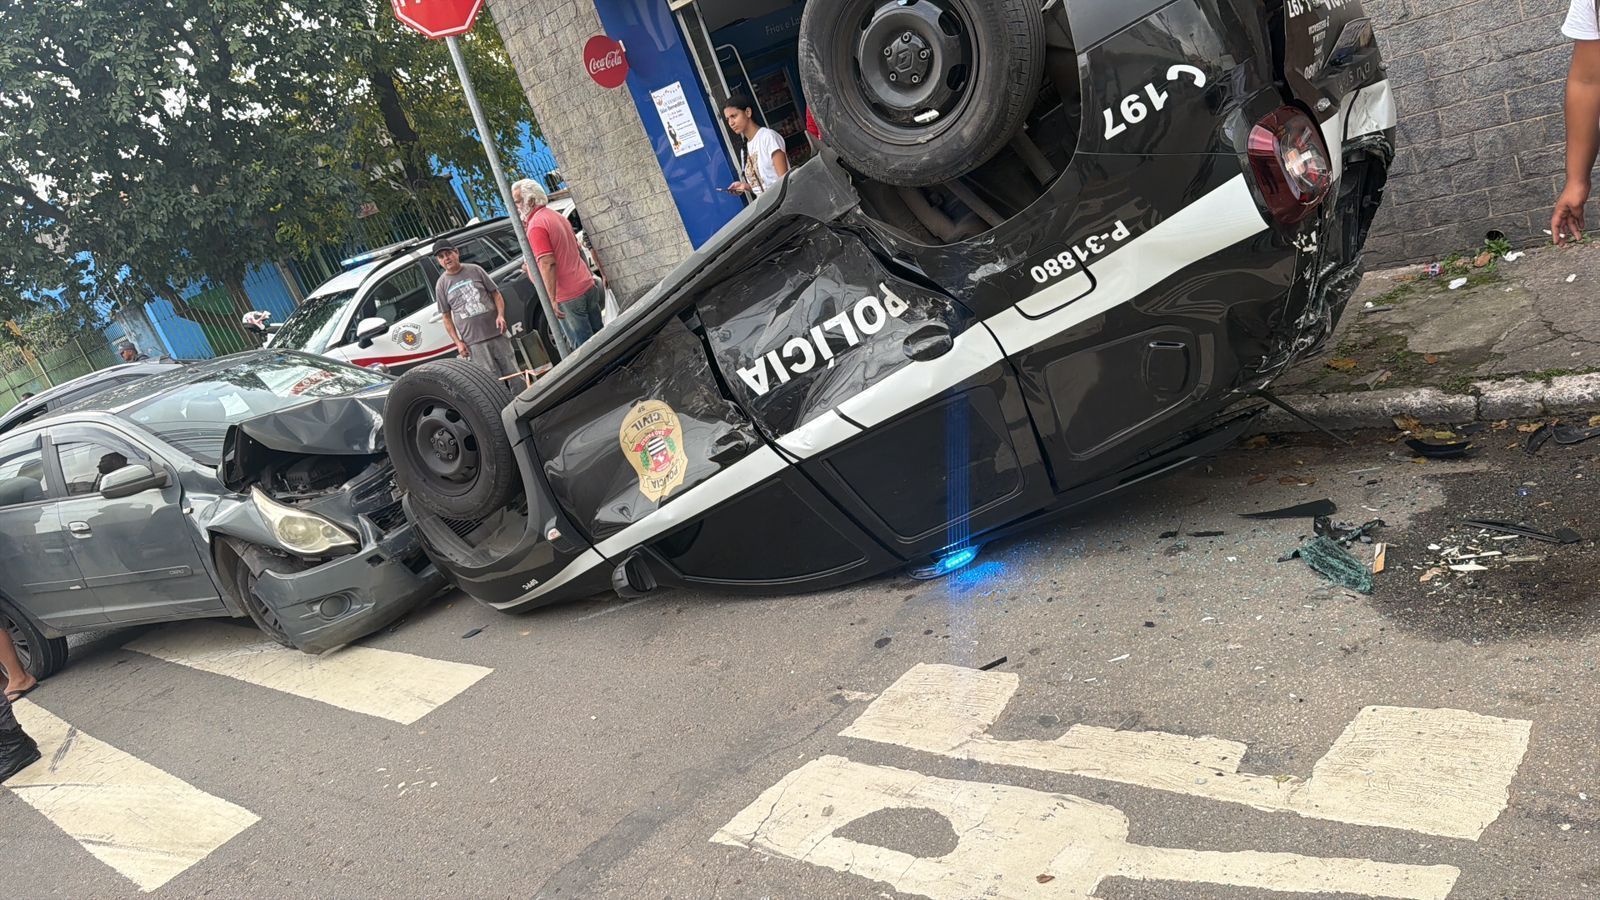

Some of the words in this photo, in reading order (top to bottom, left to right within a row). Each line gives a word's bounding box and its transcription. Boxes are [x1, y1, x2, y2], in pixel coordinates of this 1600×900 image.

[1287, 0, 1304, 18] 197
[1102, 82, 1169, 141] 197
[1030, 220, 1131, 283] P-31880
[736, 282, 909, 396] POLÍCIA
[631, 412, 660, 431] CIVIL
